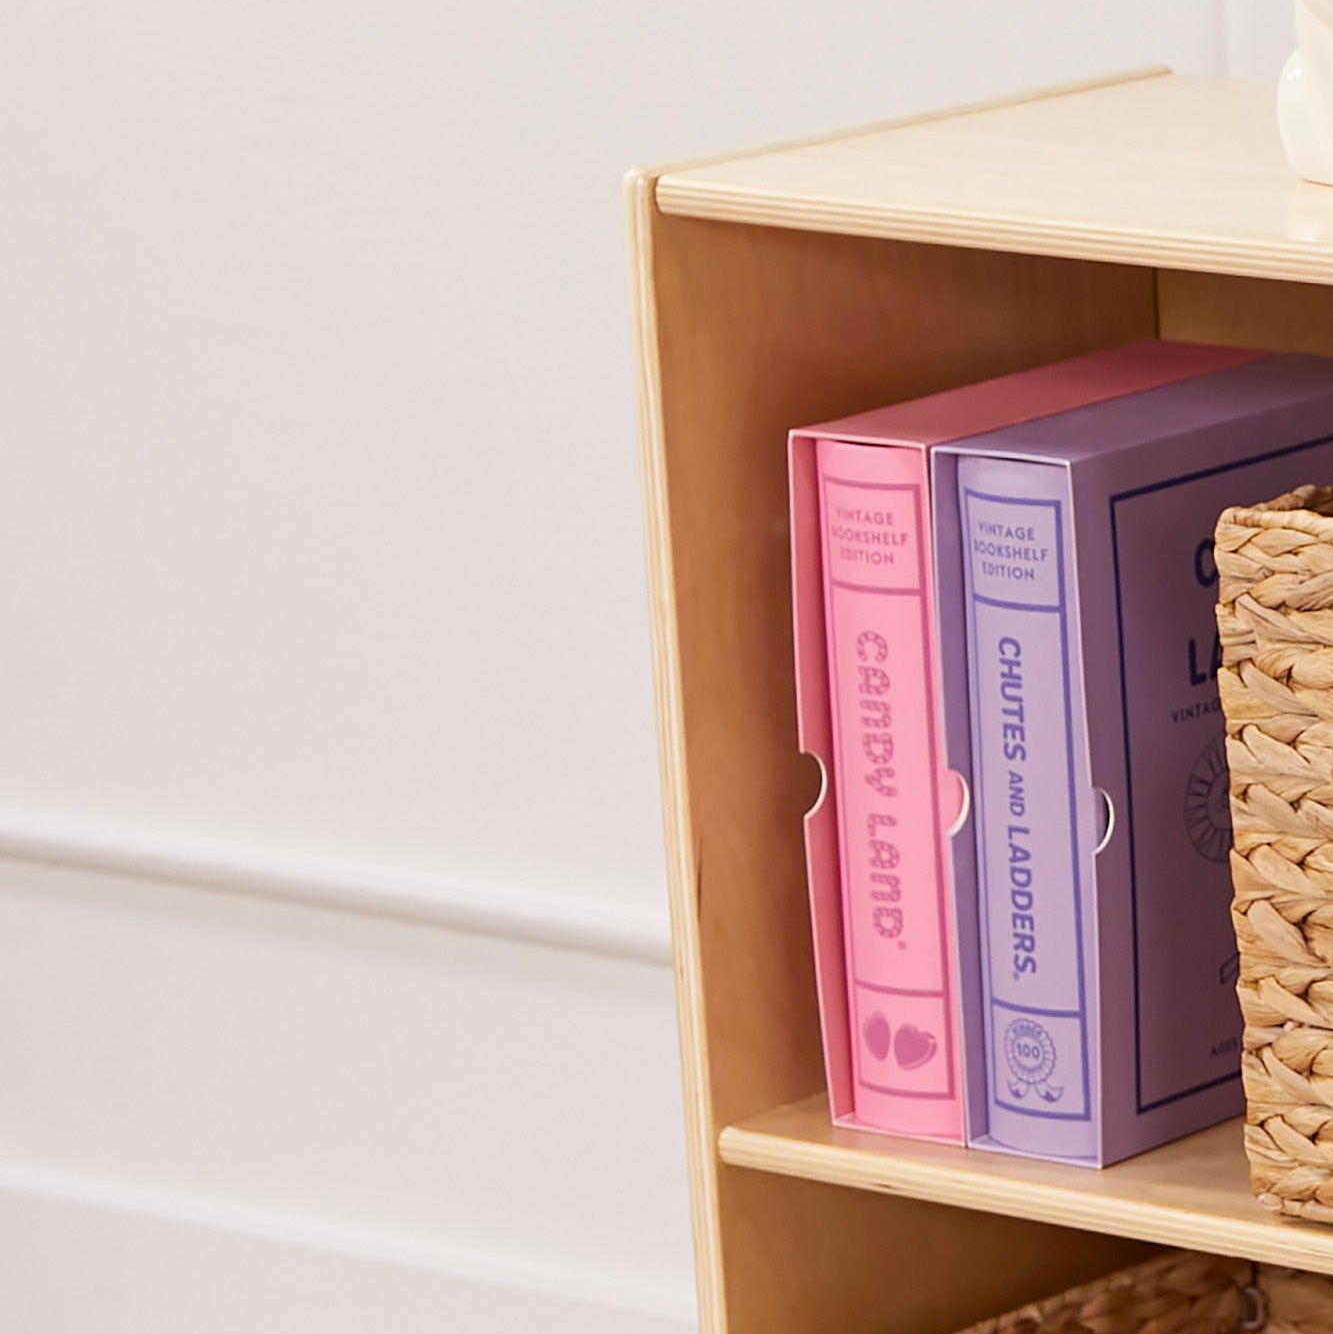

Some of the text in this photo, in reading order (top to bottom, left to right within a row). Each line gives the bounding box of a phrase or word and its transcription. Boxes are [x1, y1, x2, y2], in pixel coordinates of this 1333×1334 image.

[836, 507, 895, 526] VINTAGE
[831, 525, 908, 546] BOOKSHELF
[978, 520, 1036, 541] VINTAGE
[841, 547, 895, 565] EDITION
[974, 538, 1049, 562] BOOKSHELF
[982, 561, 1035, 580] EDITION
[998, 636, 1027, 762] CHUTES
[1008, 770, 1026, 817] AND
[1016, 1042, 1041, 1060] 100
